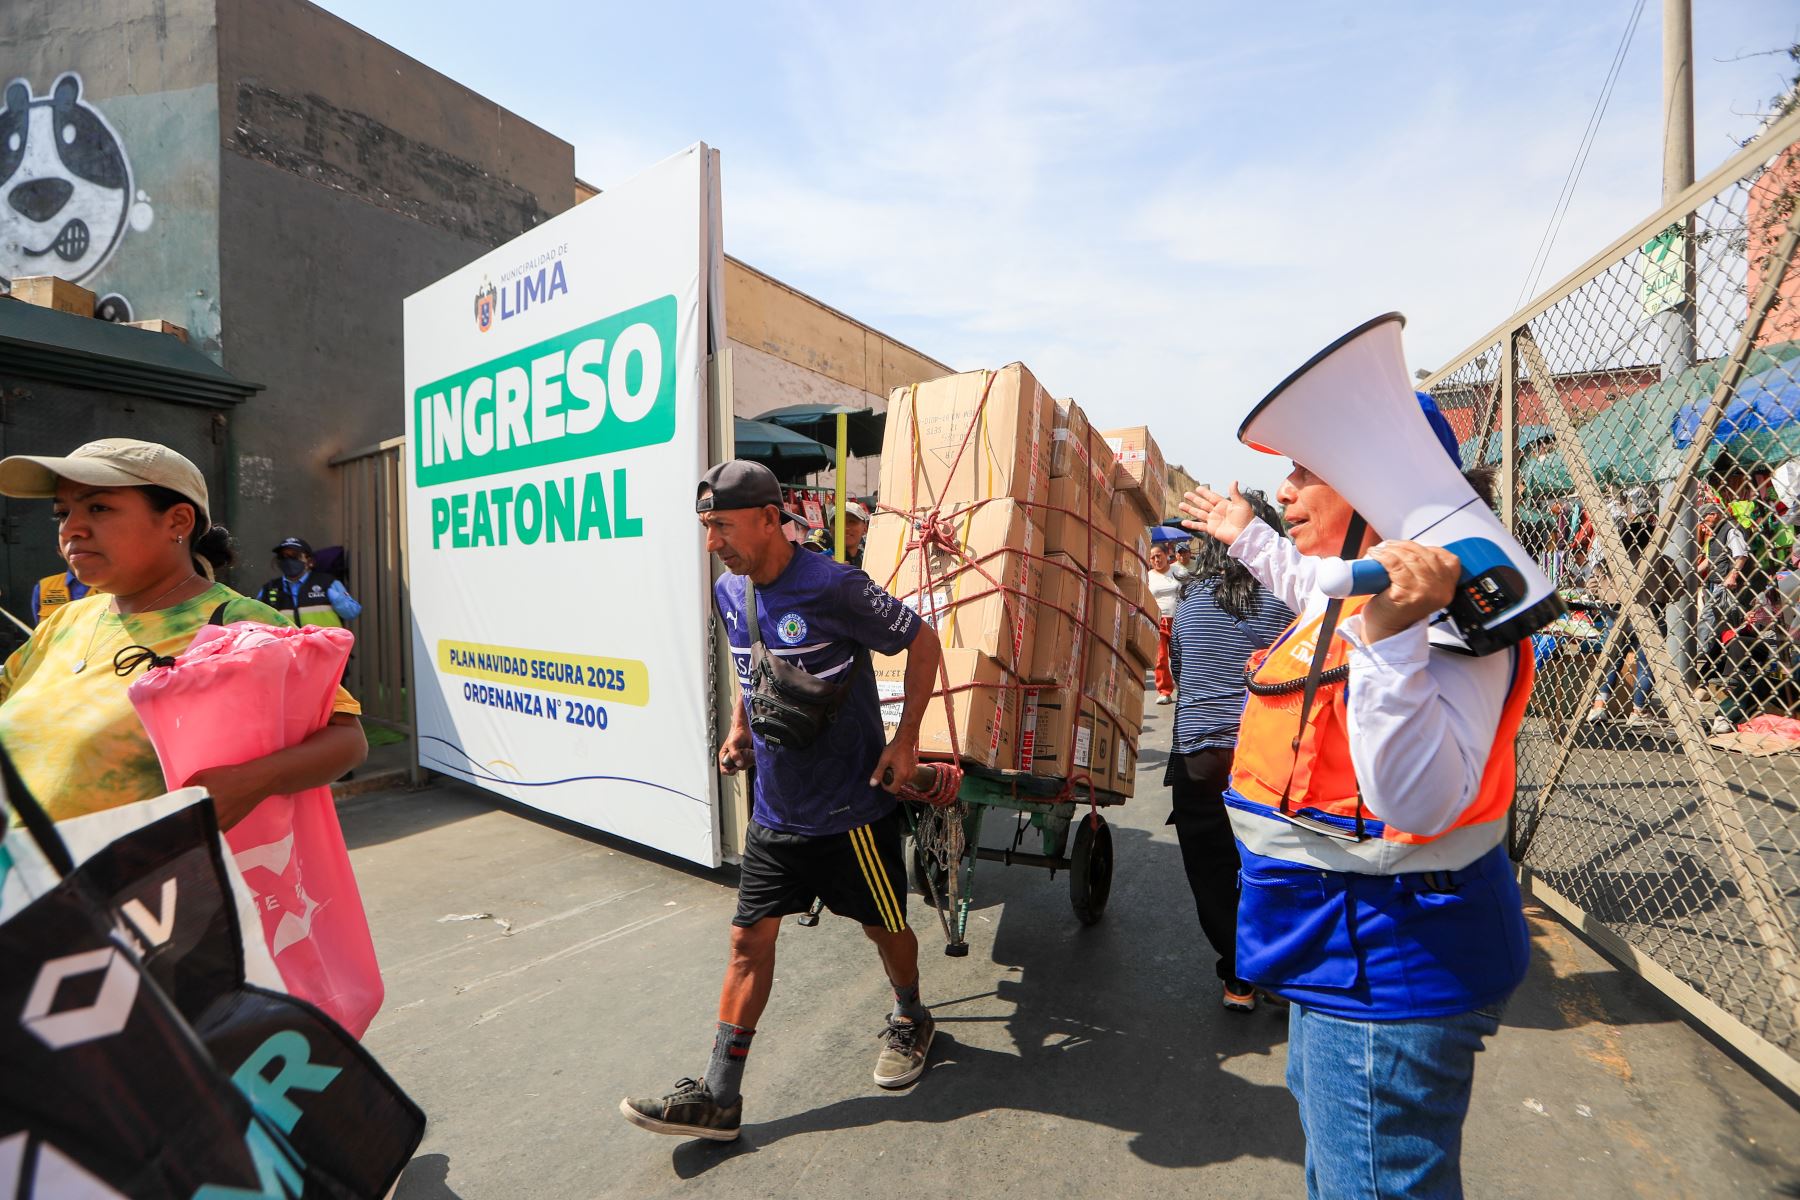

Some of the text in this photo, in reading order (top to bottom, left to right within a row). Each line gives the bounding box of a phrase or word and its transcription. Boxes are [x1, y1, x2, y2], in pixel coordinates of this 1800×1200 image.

[501, 242, 569, 281] MUNICIPALIDAD DE
[501, 260, 568, 321] LIMA
[421, 322, 662, 468] INGRESO
[432, 468, 643, 549] PEATONAL
[450, 649, 626, 692] PLAN NAVIDAD SEGURA 2025
[463, 682, 543, 717] ORDENANZA
[565, 701, 608, 731] 2200
